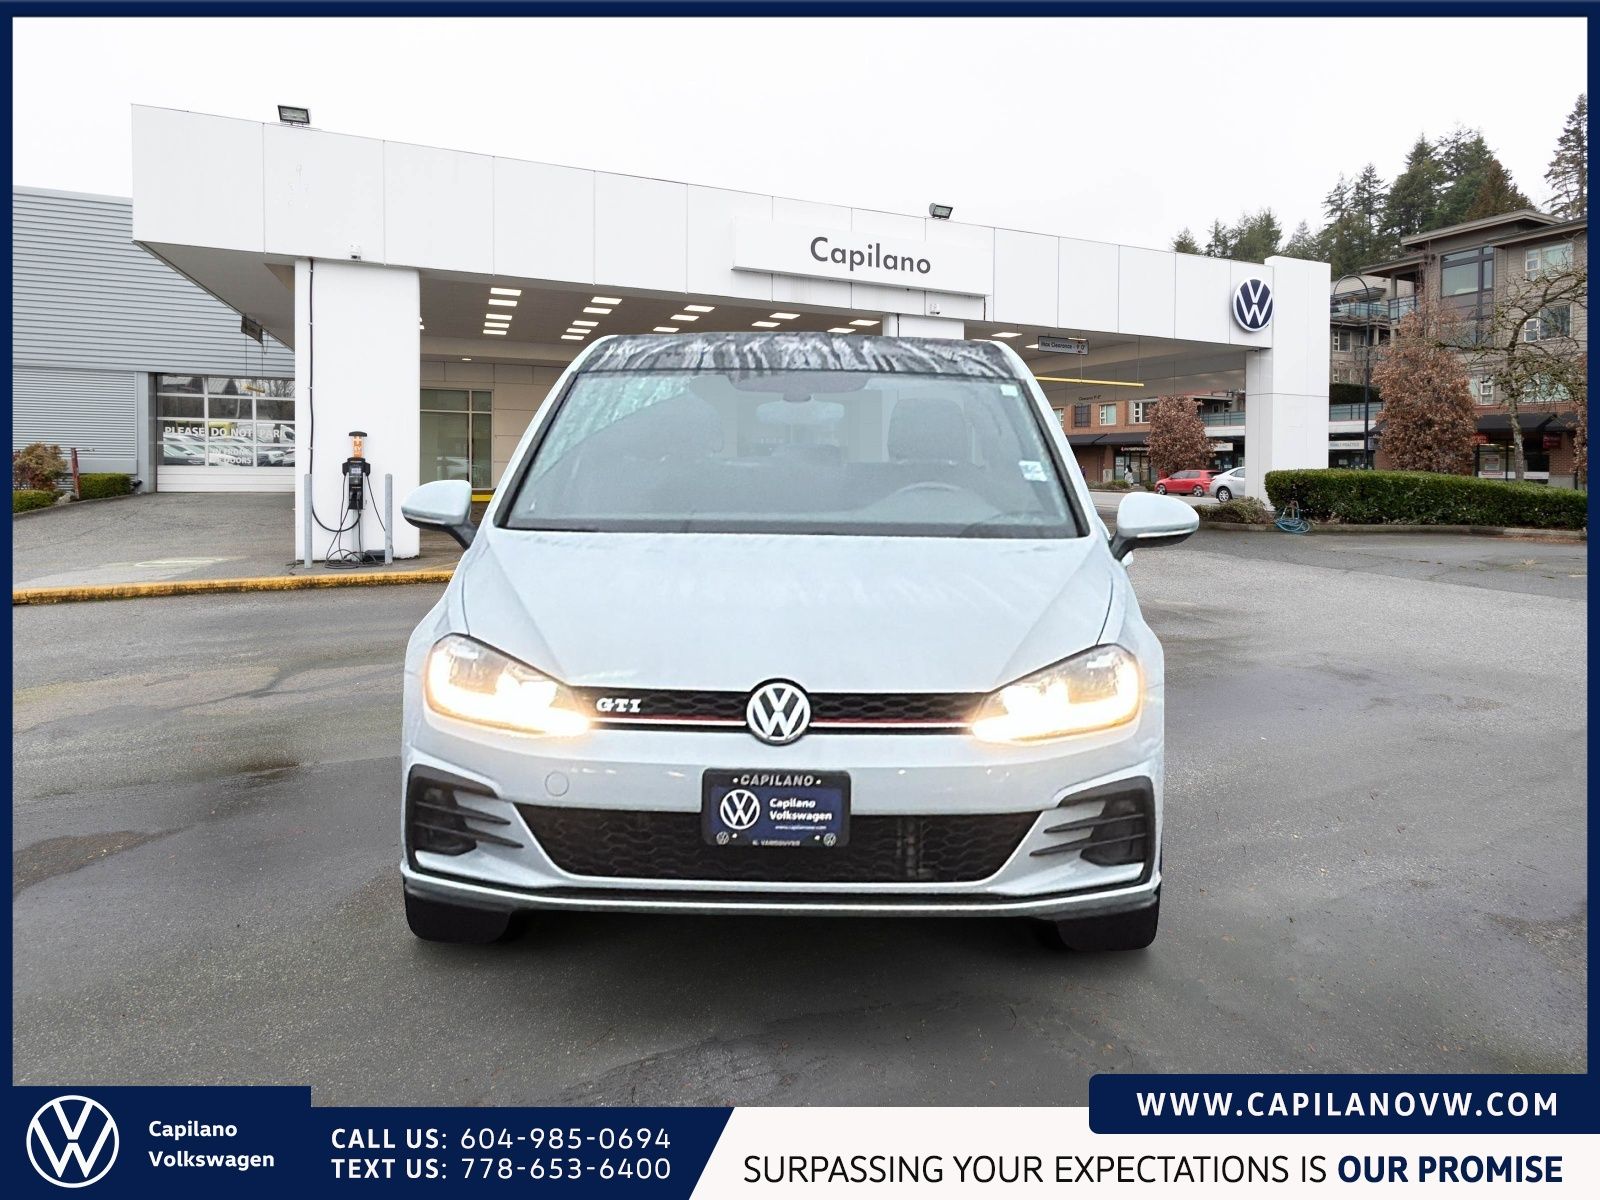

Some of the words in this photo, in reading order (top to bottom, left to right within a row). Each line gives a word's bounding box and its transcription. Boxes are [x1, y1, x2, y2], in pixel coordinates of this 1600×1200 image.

[810, 236, 931, 274] Capilano
[164, 426, 205, 436] PLEASE
[211, 428, 227, 437] DO
[231, 428, 253, 437] NOT
[596, 698, 641, 712] GTI
[740, 774, 814, 786] CAPILANO
[769, 798, 816, 809] Capilano
[769, 810, 832, 822] Volkswagen
